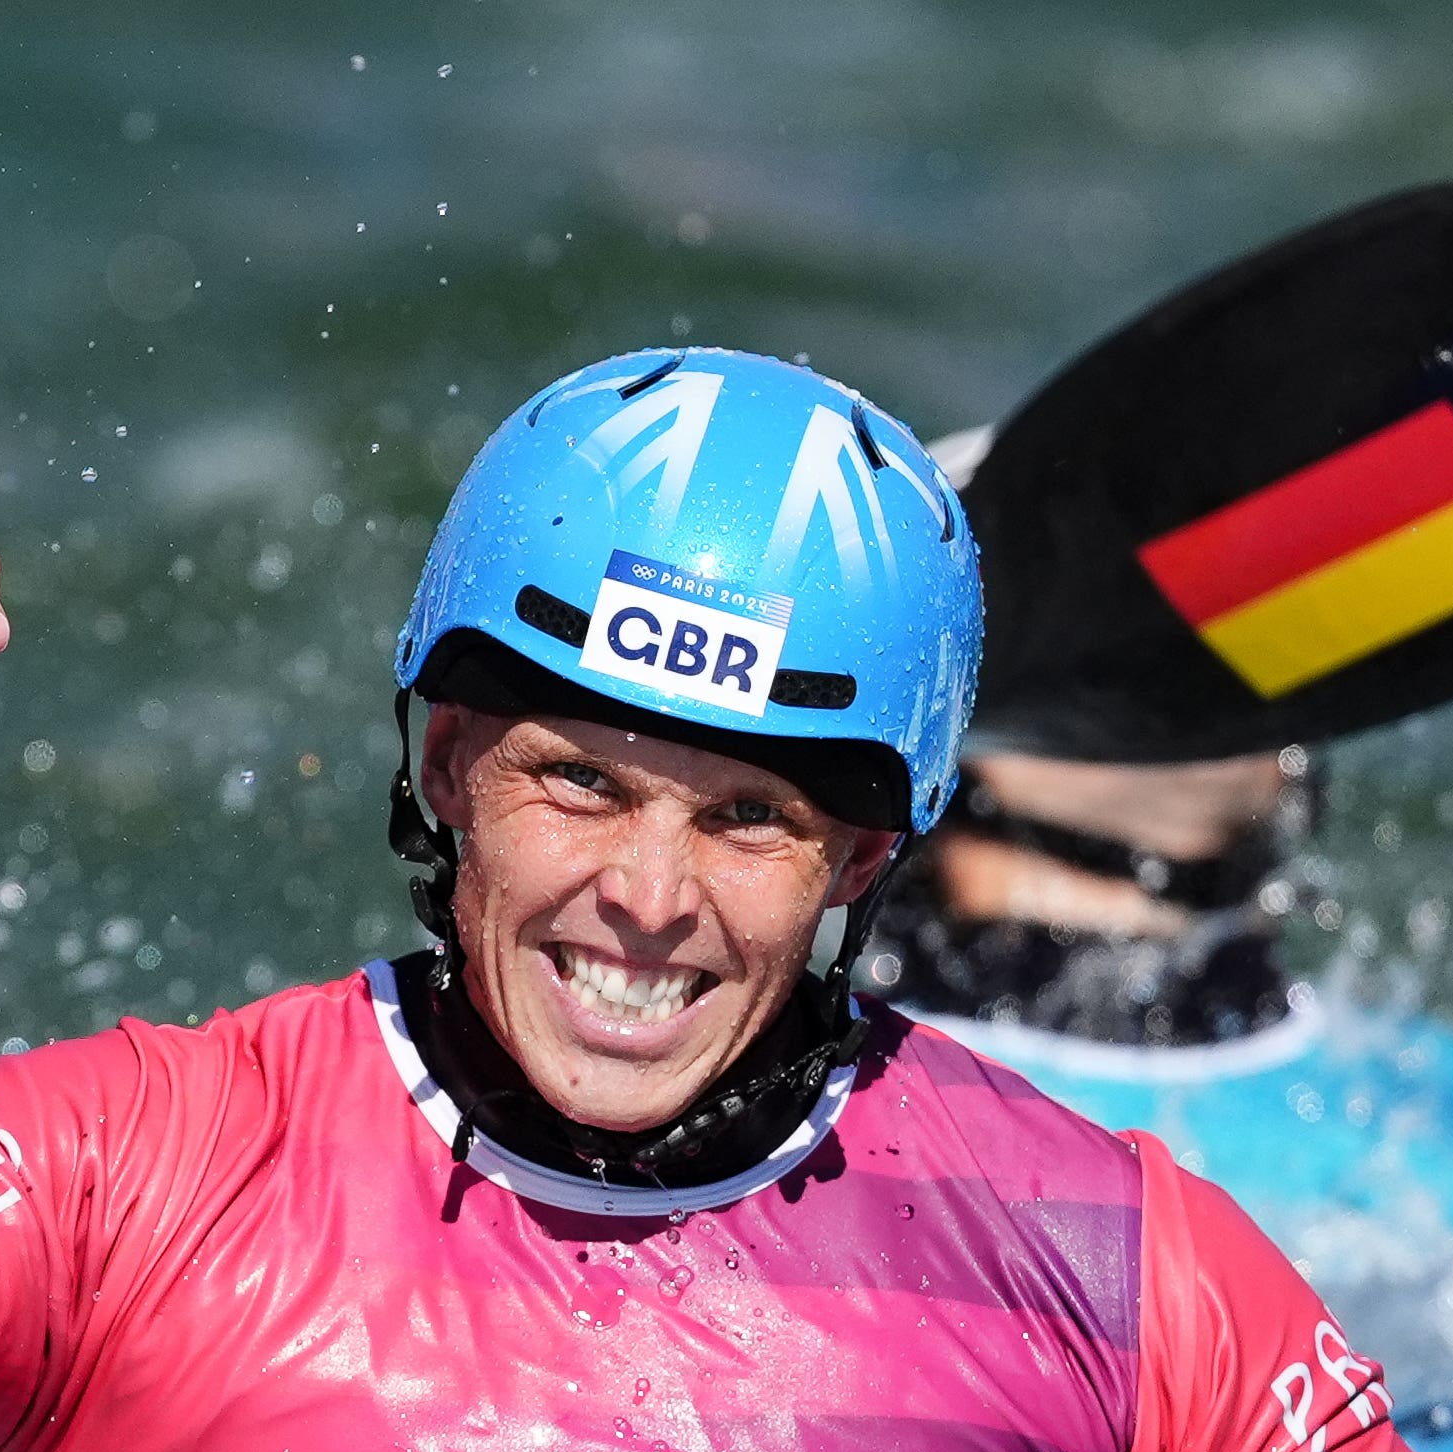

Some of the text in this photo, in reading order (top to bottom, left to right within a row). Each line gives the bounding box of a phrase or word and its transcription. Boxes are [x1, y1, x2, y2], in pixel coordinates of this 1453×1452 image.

[660, 572, 769, 615] PARIS 2024
[607, 606, 759, 693] GBR
